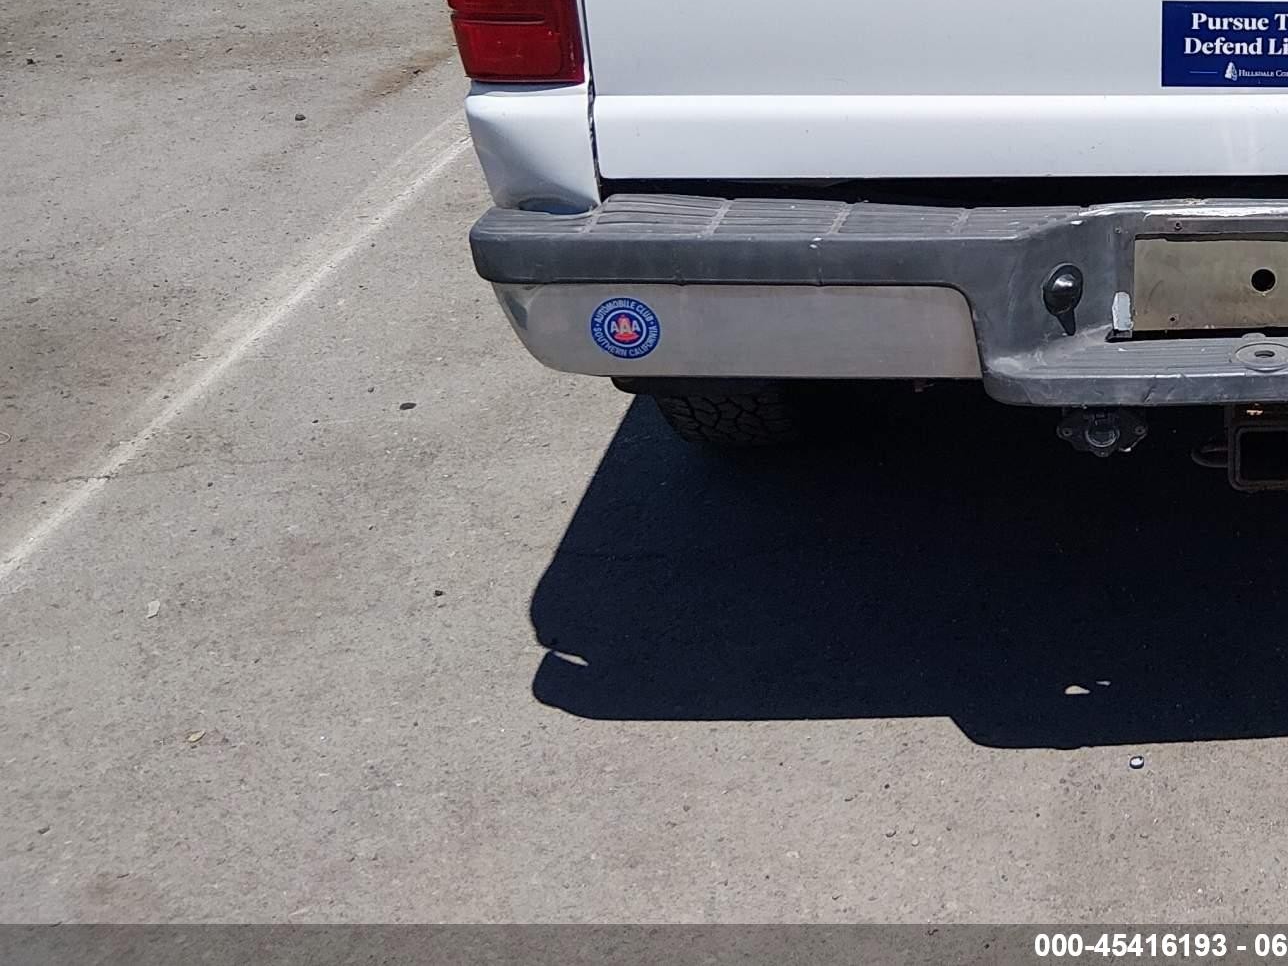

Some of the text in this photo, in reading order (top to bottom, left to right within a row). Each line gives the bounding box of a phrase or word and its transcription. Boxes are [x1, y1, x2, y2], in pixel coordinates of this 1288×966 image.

[1191, 12, 1269, 31] Pursue
[1184, 37, 1263, 55] Defend
[594, 299, 654, 323] AUTOMOBILE CLUB
[610, 316, 641, 334] AAA
[593, 325, 658, 357] SOUTHERN CALIFORNIA
